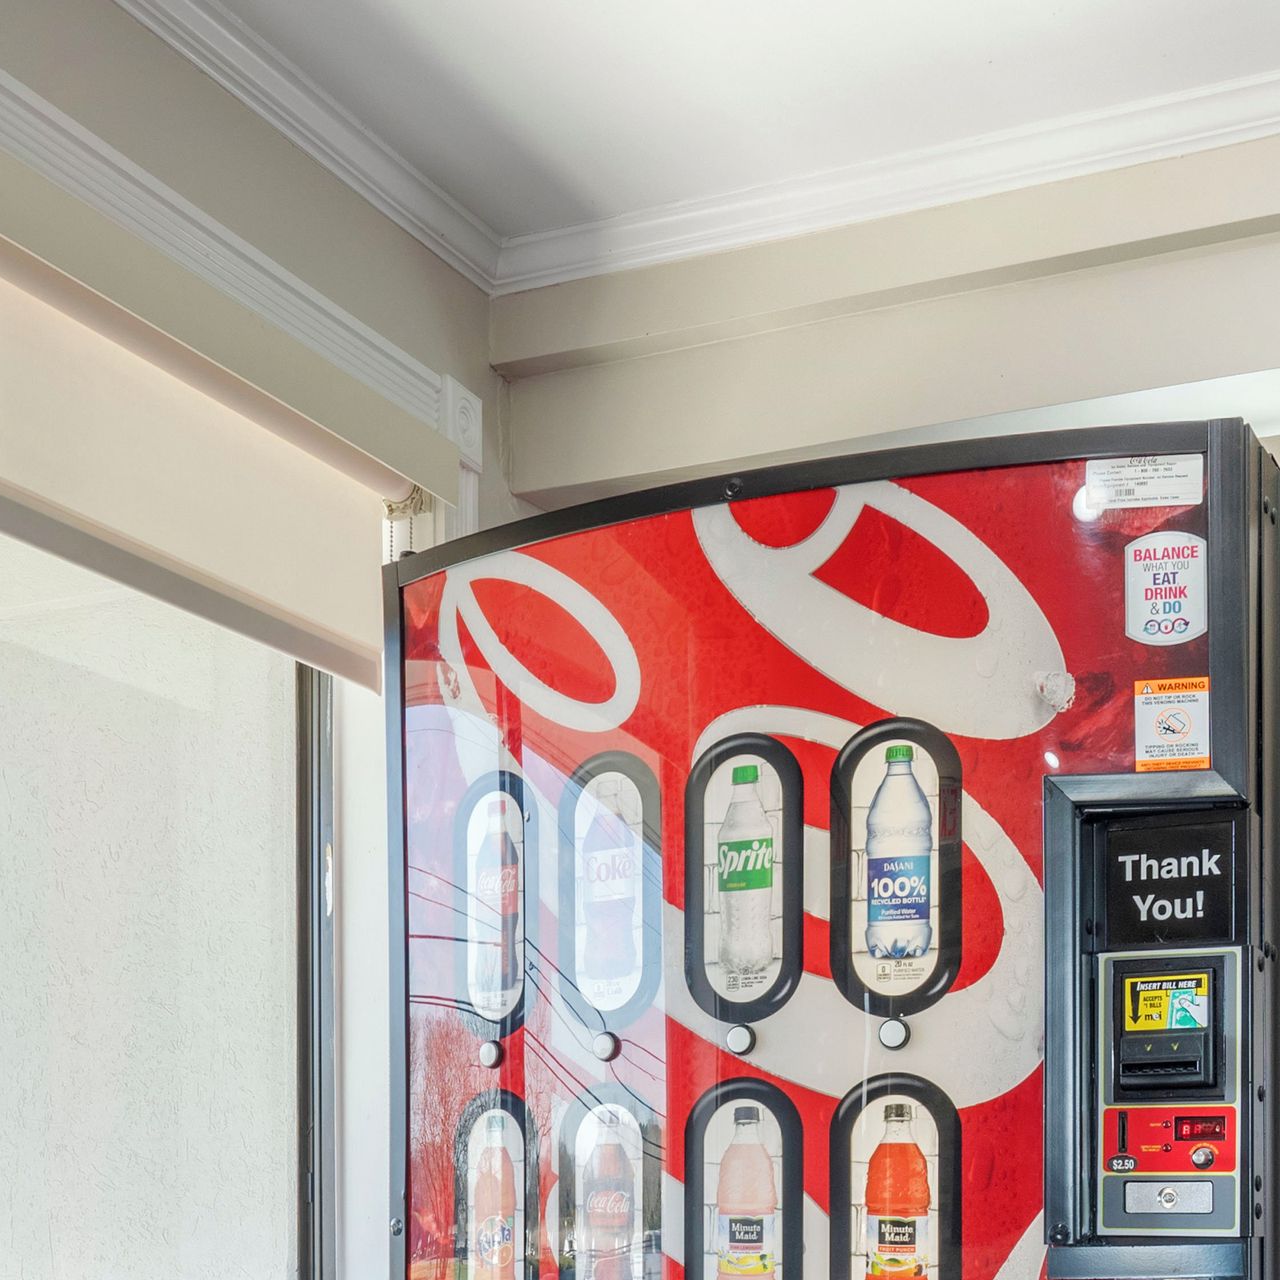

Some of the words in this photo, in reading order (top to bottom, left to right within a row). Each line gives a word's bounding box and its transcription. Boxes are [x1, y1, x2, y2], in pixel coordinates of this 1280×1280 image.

[1134, 545, 1198, 562] BALANCE
[1143, 562, 1168, 572] WHAT
[1172, 561, 1189, 570] YOU
[1144, 586, 1188, 600] DRINK
[1150, 602, 1159, 615] &
[1163, 601, 1182, 614] DO
[1158, 681, 1206, 691] WARNING
[719, 841, 772, 879] Sprite
[1118, 849, 1221, 882] Thank
[884, 861, 913, 872] DASANI
[871, 876, 926, 898] 100%
[1133, 890, 1204, 922] You!
[1137, 982, 1161, 991] INSERT
[1162, 981, 1176, 989] BILL
[1178, 980, 1197, 988] HERE
[1145, 1011, 1161, 1021] mei
[1112, 1159, 1135, 1170] $2.50
[587, 1191, 630, 1213] Coca-Cola
[732, 1223, 761, 1231] Minute
[881, 1224, 914, 1233] Minute
[736, 1232, 758, 1240] Maid
[885, 1233, 910, 1241] Maid
